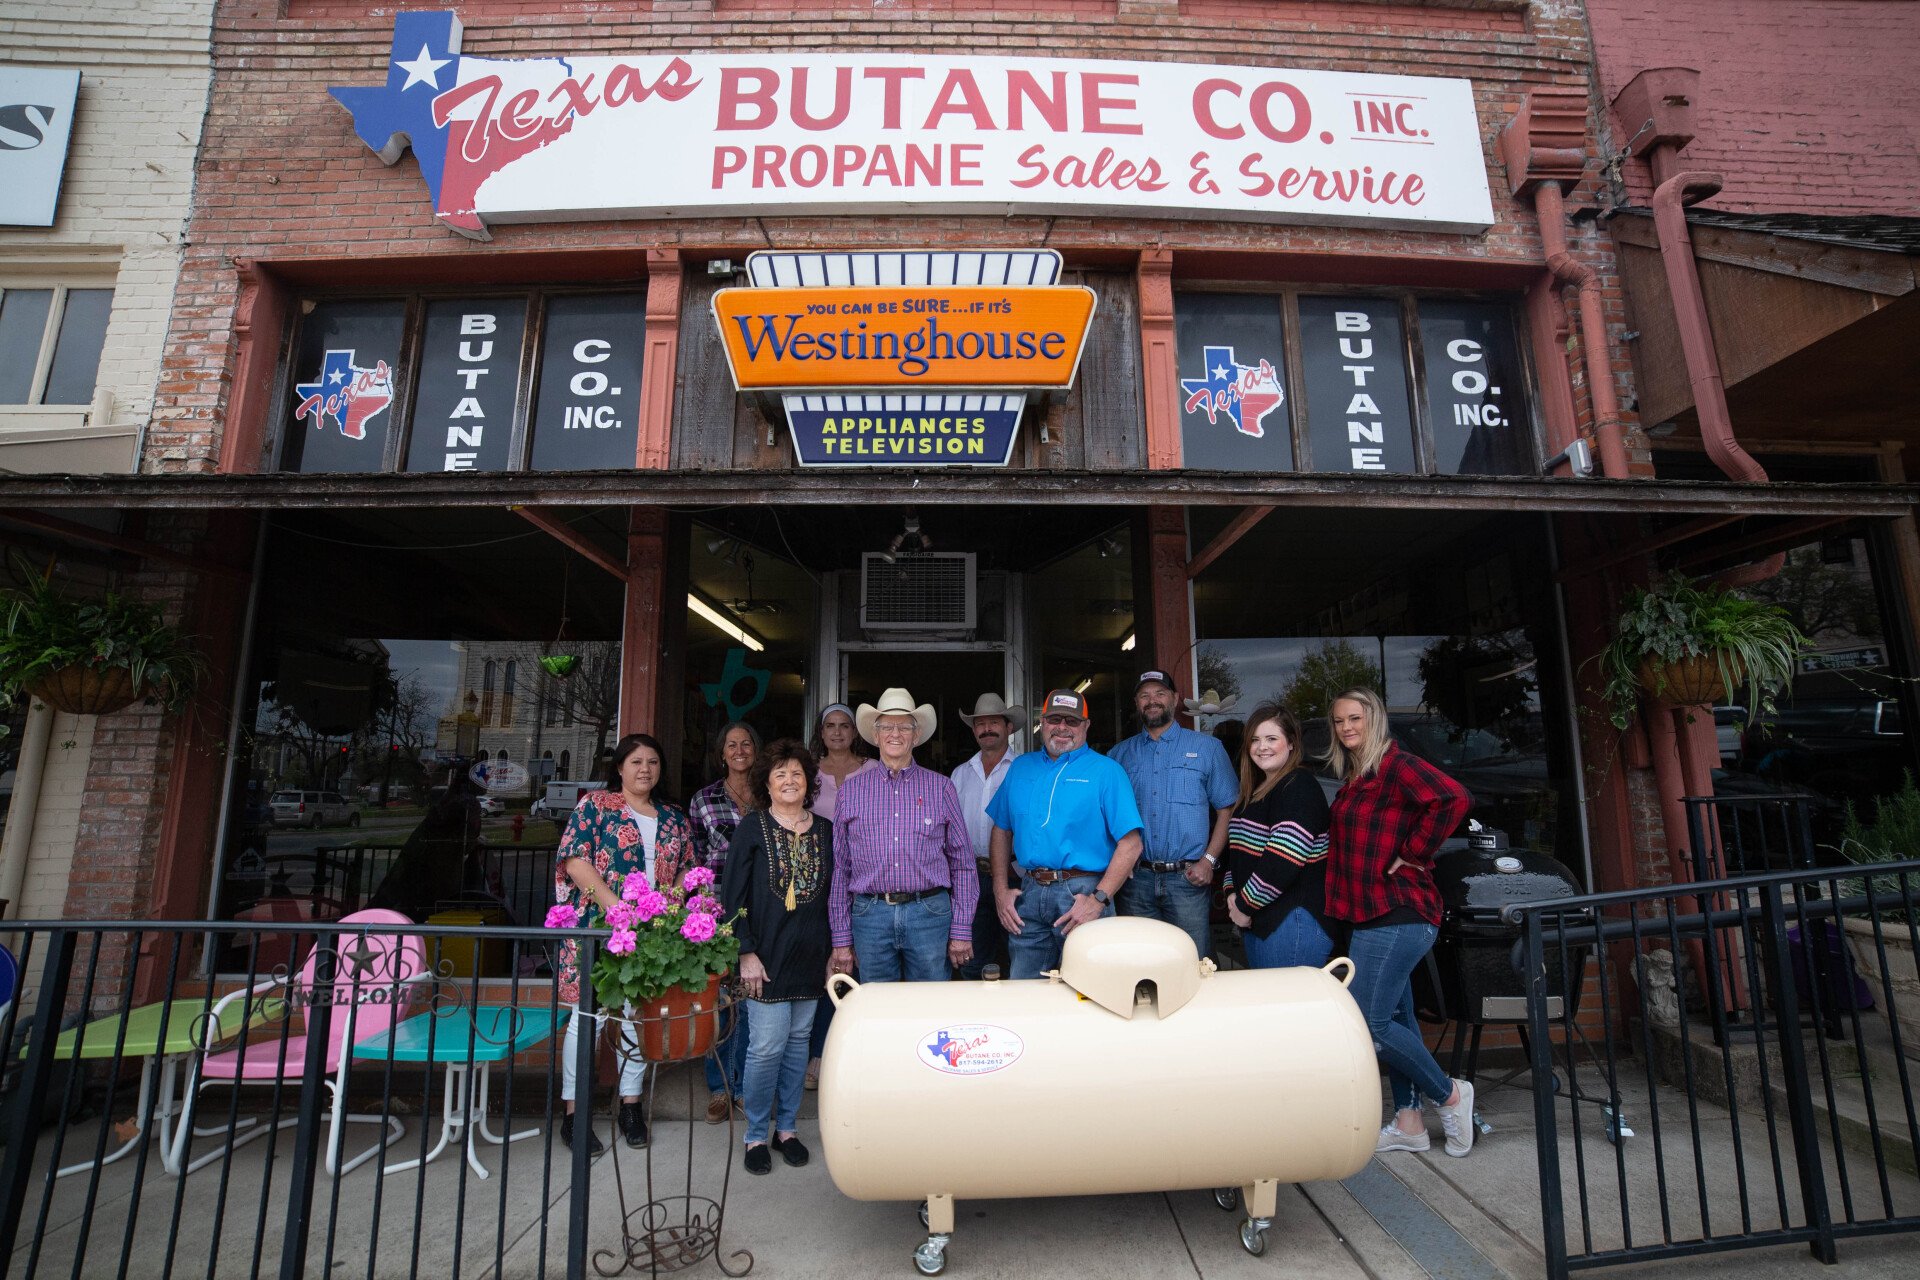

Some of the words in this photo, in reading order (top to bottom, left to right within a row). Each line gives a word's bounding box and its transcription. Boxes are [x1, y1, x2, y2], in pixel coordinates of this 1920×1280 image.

[431, 56, 704, 163] Texas
[712, 66, 1144, 136] BUTANE
[1192, 78, 1335, 145] CO.
[1353, 100, 1430, 138] INC.
[711, 143, 984, 190] PROPANE
[1009, 143, 1171, 192] Sales
[1188, 150, 1221, 195] &
[1238, 152, 1426, 206] Service
[806, 303, 837, 316] YOU
[841, 302, 873, 315] CAN
[877, 301, 898, 314] BE
[988, 298, 1012, 314] IT'S
[731, 313, 1066, 377] Westinghouse
[295, 359, 392, 430] Texas
[444, 313, 497, 472] BUTANE
[563, 405, 622, 430] INC.
[1185, 358, 1275, 425] Texas
[1334, 311, 1386, 471] BUTANE
[1453, 403, 1509, 427] INC.
[821, 417, 986, 434] APPLIANCES
[822, 437, 985, 454] TELEVISION
[294, 987, 427, 1007] WELCOME
[941, 1033, 990, 1059] Texas
